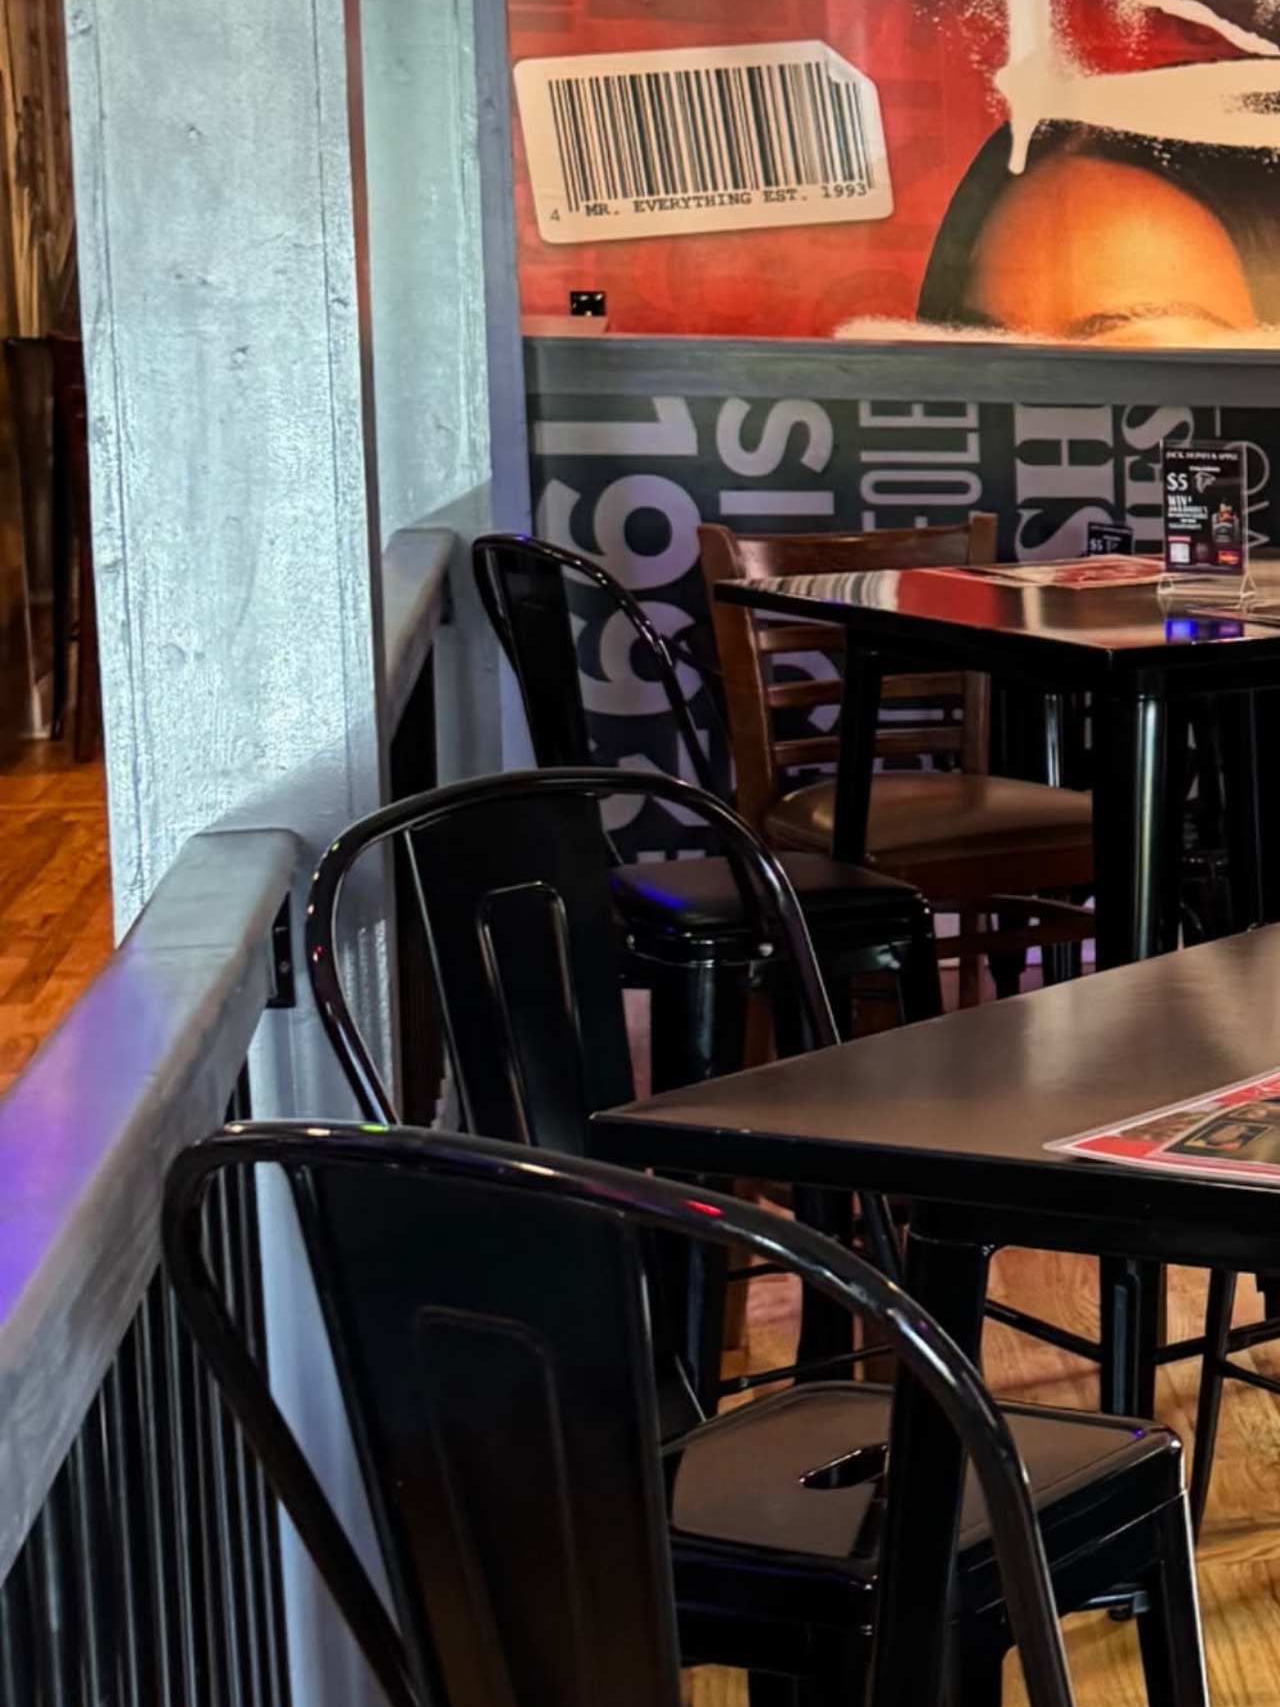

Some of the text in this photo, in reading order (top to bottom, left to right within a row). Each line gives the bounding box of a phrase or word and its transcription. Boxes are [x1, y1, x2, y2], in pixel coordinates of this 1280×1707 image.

[586, 203, 620, 217] MR.
[633, 193, 753, 214] EVERYTHING
[763, 188, 808, 204] EST.
[821, 182, 869, 200] 1993
